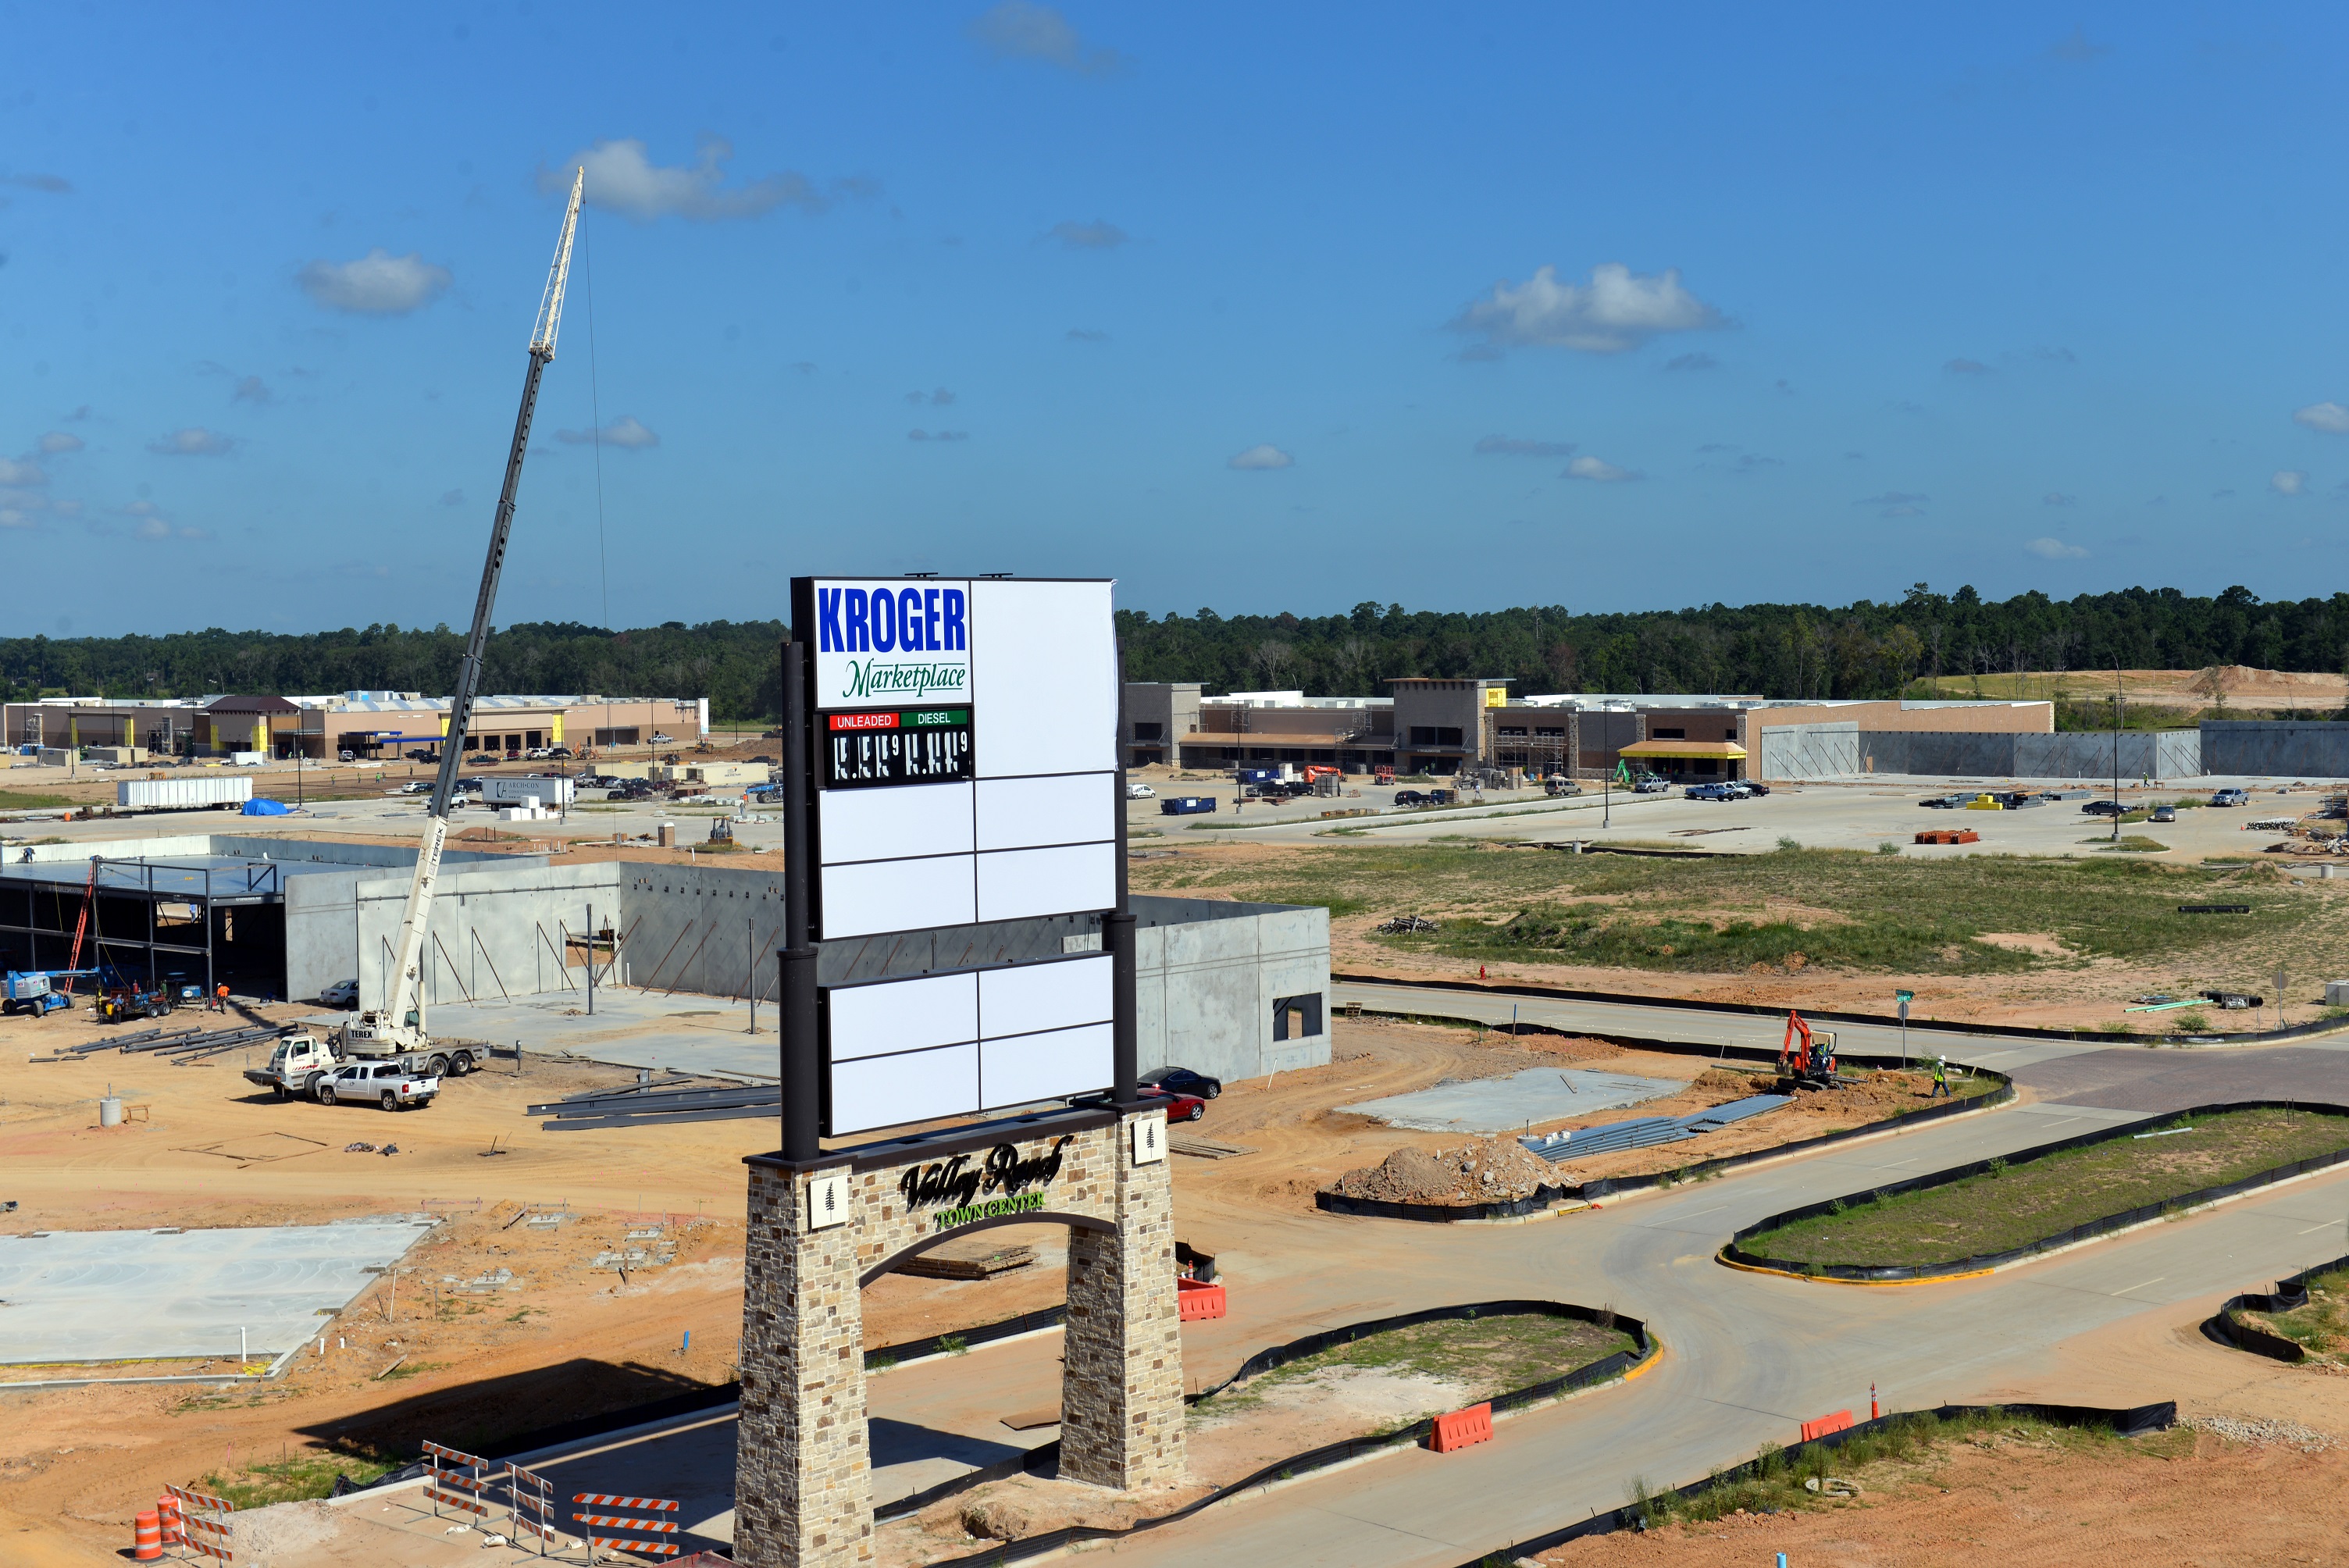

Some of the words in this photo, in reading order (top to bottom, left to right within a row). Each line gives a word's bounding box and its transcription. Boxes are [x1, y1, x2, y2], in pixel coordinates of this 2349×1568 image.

[818, 588, 965, 653] KROGER
[843, 657, 965, 697] Marketplace
[837, 715, 892, 728] UNLEADED
[918, 712, 951, 725] DIESEL
[892, 734, 899, 756] 9
[961, 731, 968, 752] 9
[432, 828, 444, 862] TEREX
[351, 1030, 372, 1039] TEREX
[900, 1155, 983, 1210] Valley
[936, 1203, 985, 1227] TOWN
[987, 1191, 1046, 1217] CENTER
